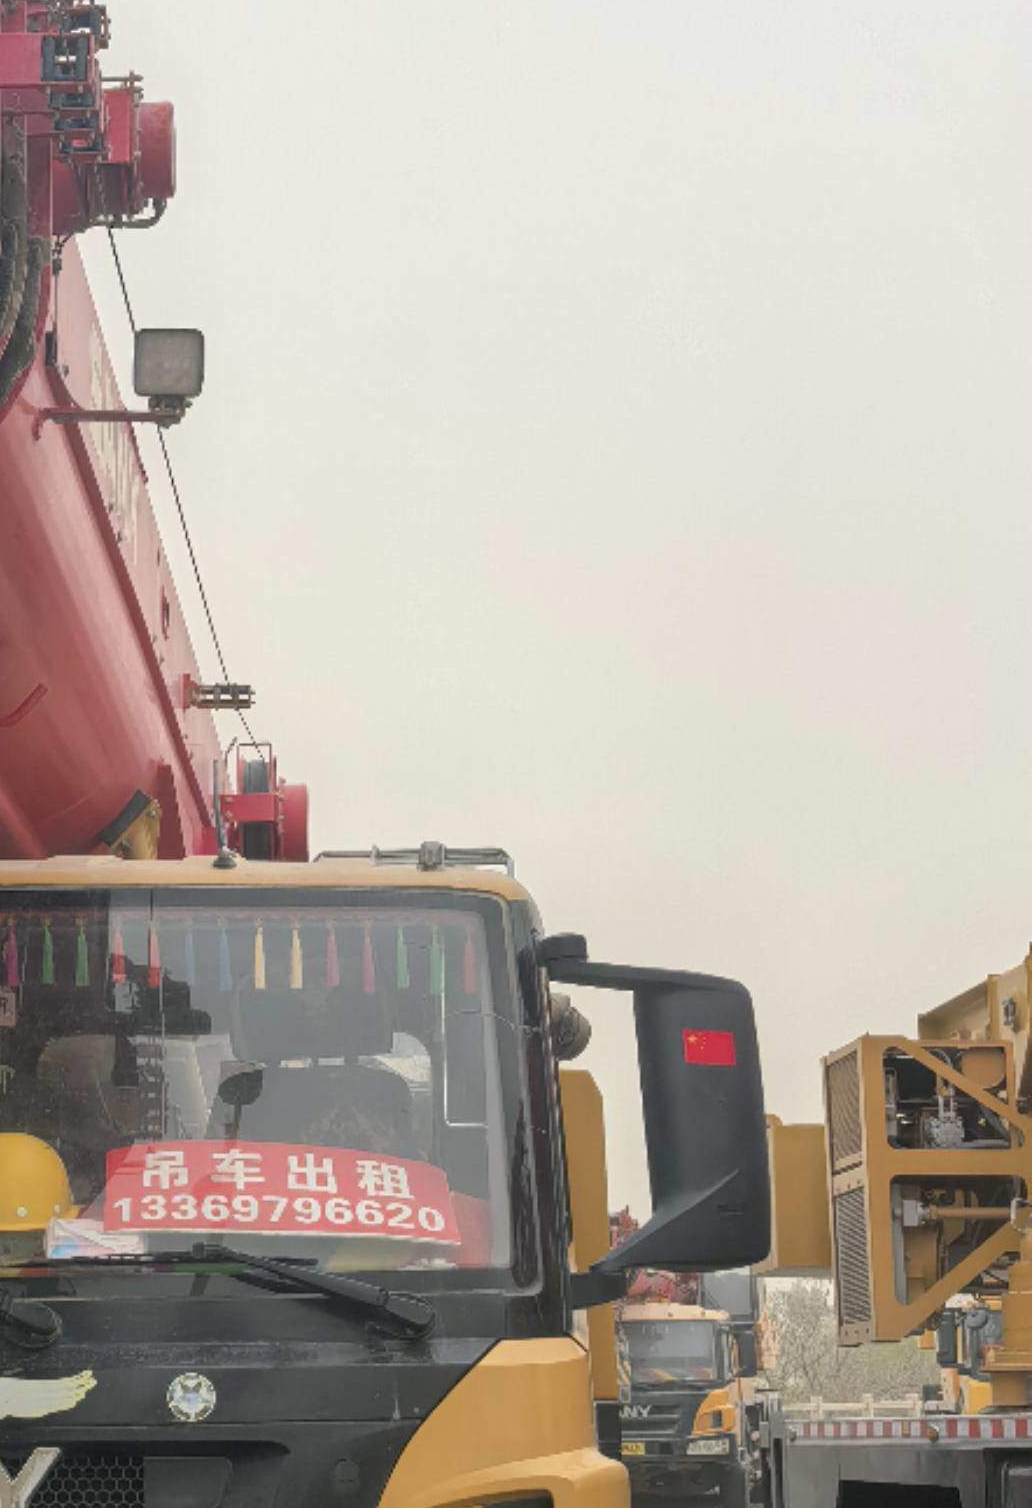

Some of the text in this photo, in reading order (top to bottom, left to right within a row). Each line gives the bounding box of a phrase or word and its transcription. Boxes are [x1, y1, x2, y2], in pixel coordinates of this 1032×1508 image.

[142, 1148, 414, 1199] 吊车出租
[113, 1194, 445, 1232] 13369796620
